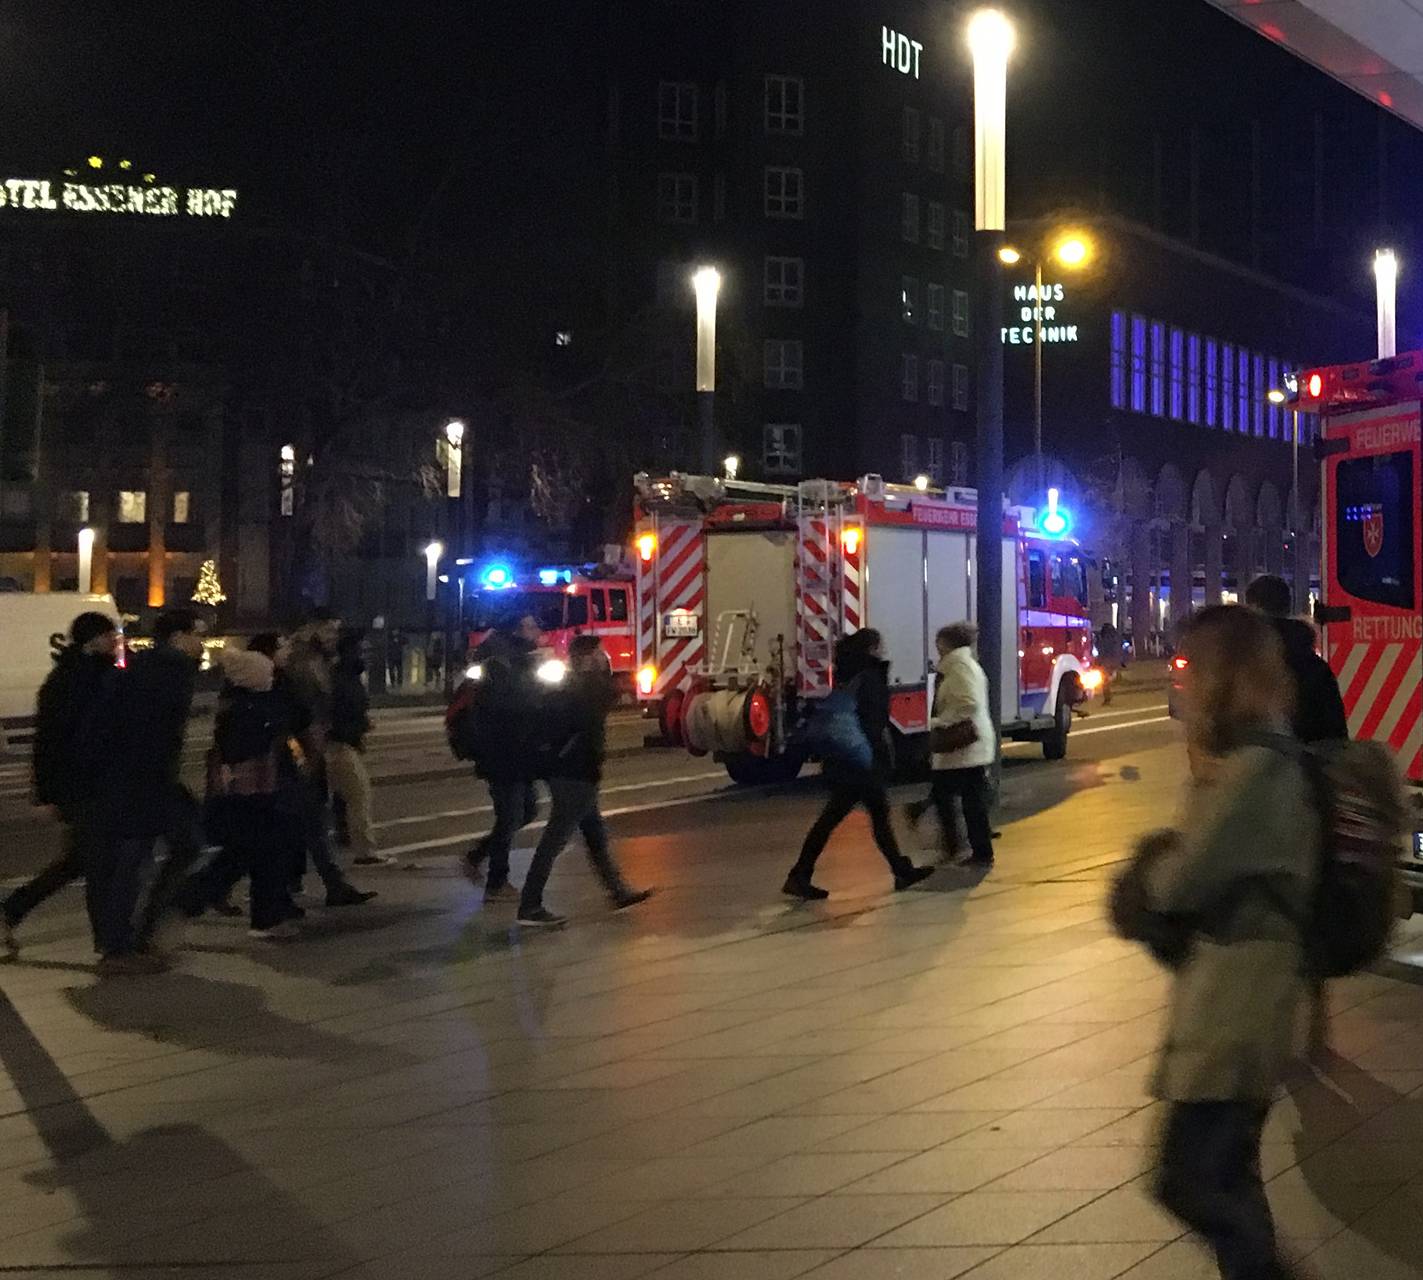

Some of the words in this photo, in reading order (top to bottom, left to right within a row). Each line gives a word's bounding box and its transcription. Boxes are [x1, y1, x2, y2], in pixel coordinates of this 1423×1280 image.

[882, 25, 923, 80] HDT
[63, 183, 178, 215] ESSENER
[187, 188, 237, 217] HOF
[1014, 283, 1064, 301] HAUS
[1021, 306, 1055, 321] DER
[1001, 325, 1078, 344] TECHNIK
